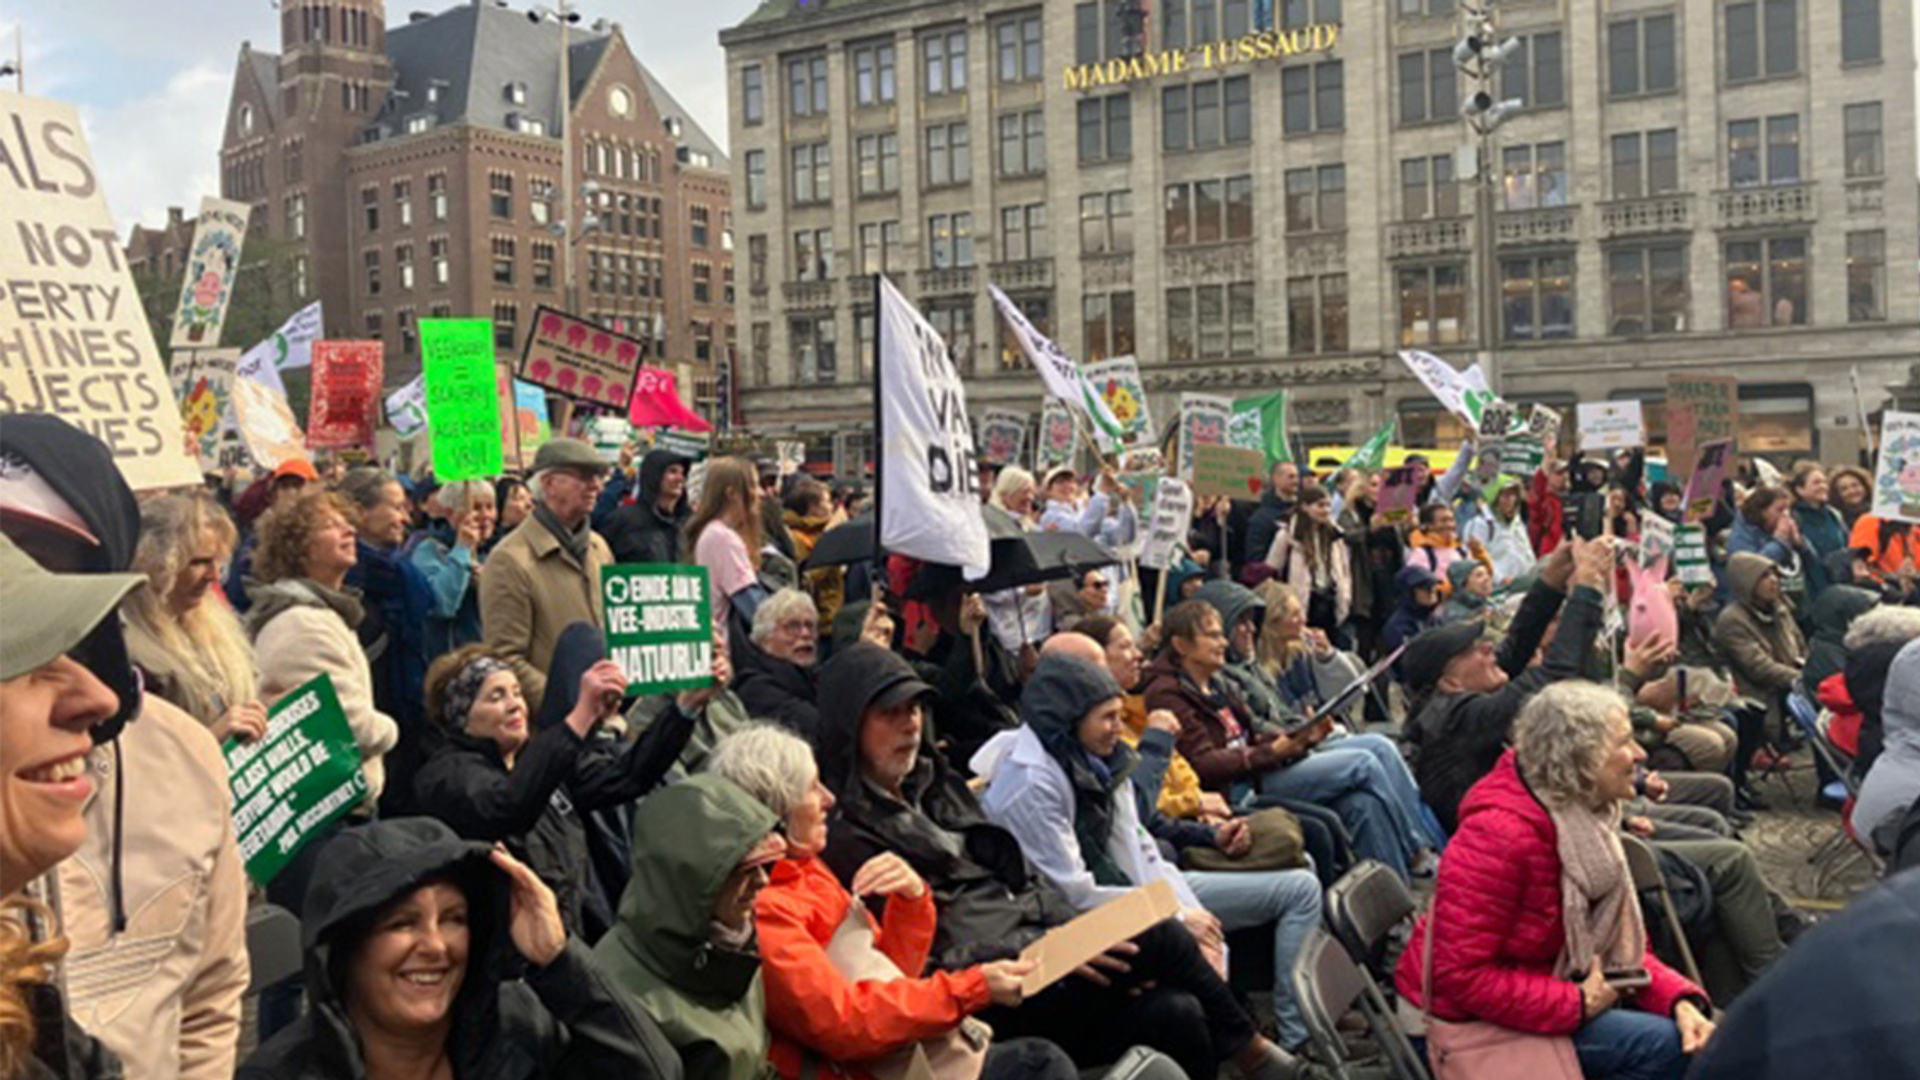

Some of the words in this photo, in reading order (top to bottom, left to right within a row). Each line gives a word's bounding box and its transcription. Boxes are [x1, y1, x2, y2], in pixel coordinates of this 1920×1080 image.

[1063, 51, 1189, 90] MADAME
[16, 220, 120, 273] NOT
[630, 575, 670, 602] EINDE
[269, 753, 314, 796] WOULD
[308, 740, 331, 767] BE
